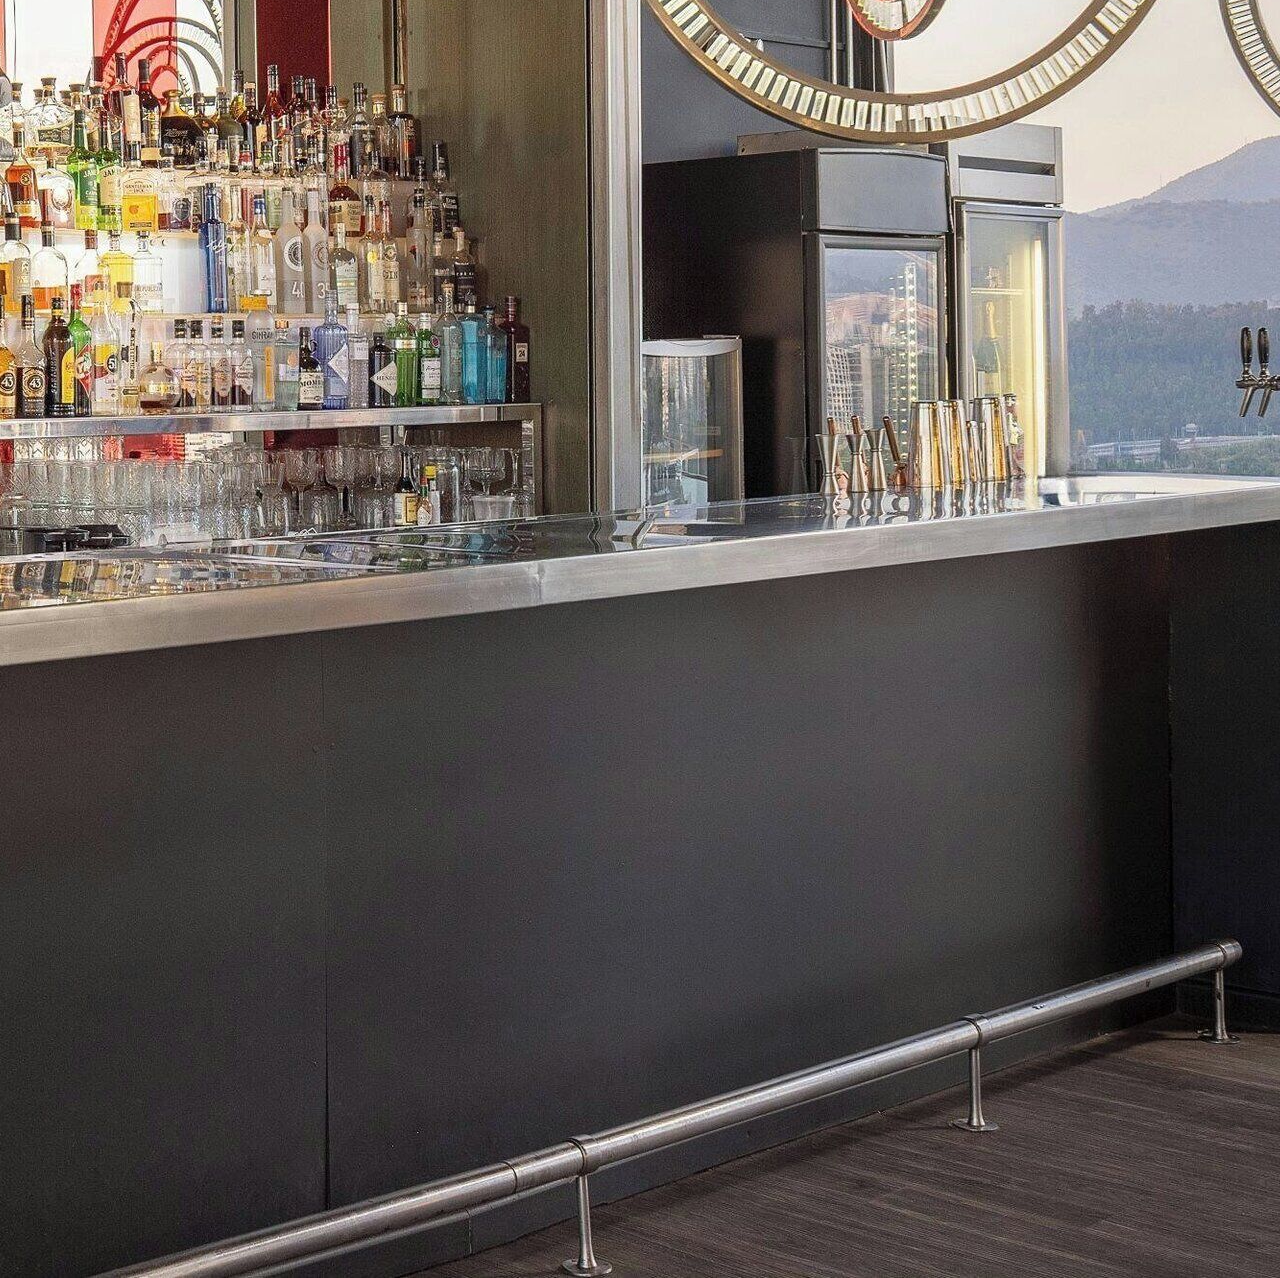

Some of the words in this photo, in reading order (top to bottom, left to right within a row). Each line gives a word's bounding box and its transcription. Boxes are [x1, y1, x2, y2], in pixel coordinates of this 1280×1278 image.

[518, 349, 526, 358] 24
[2, 375, 14, 388] 43
[29, 378, 42, 389] 43
